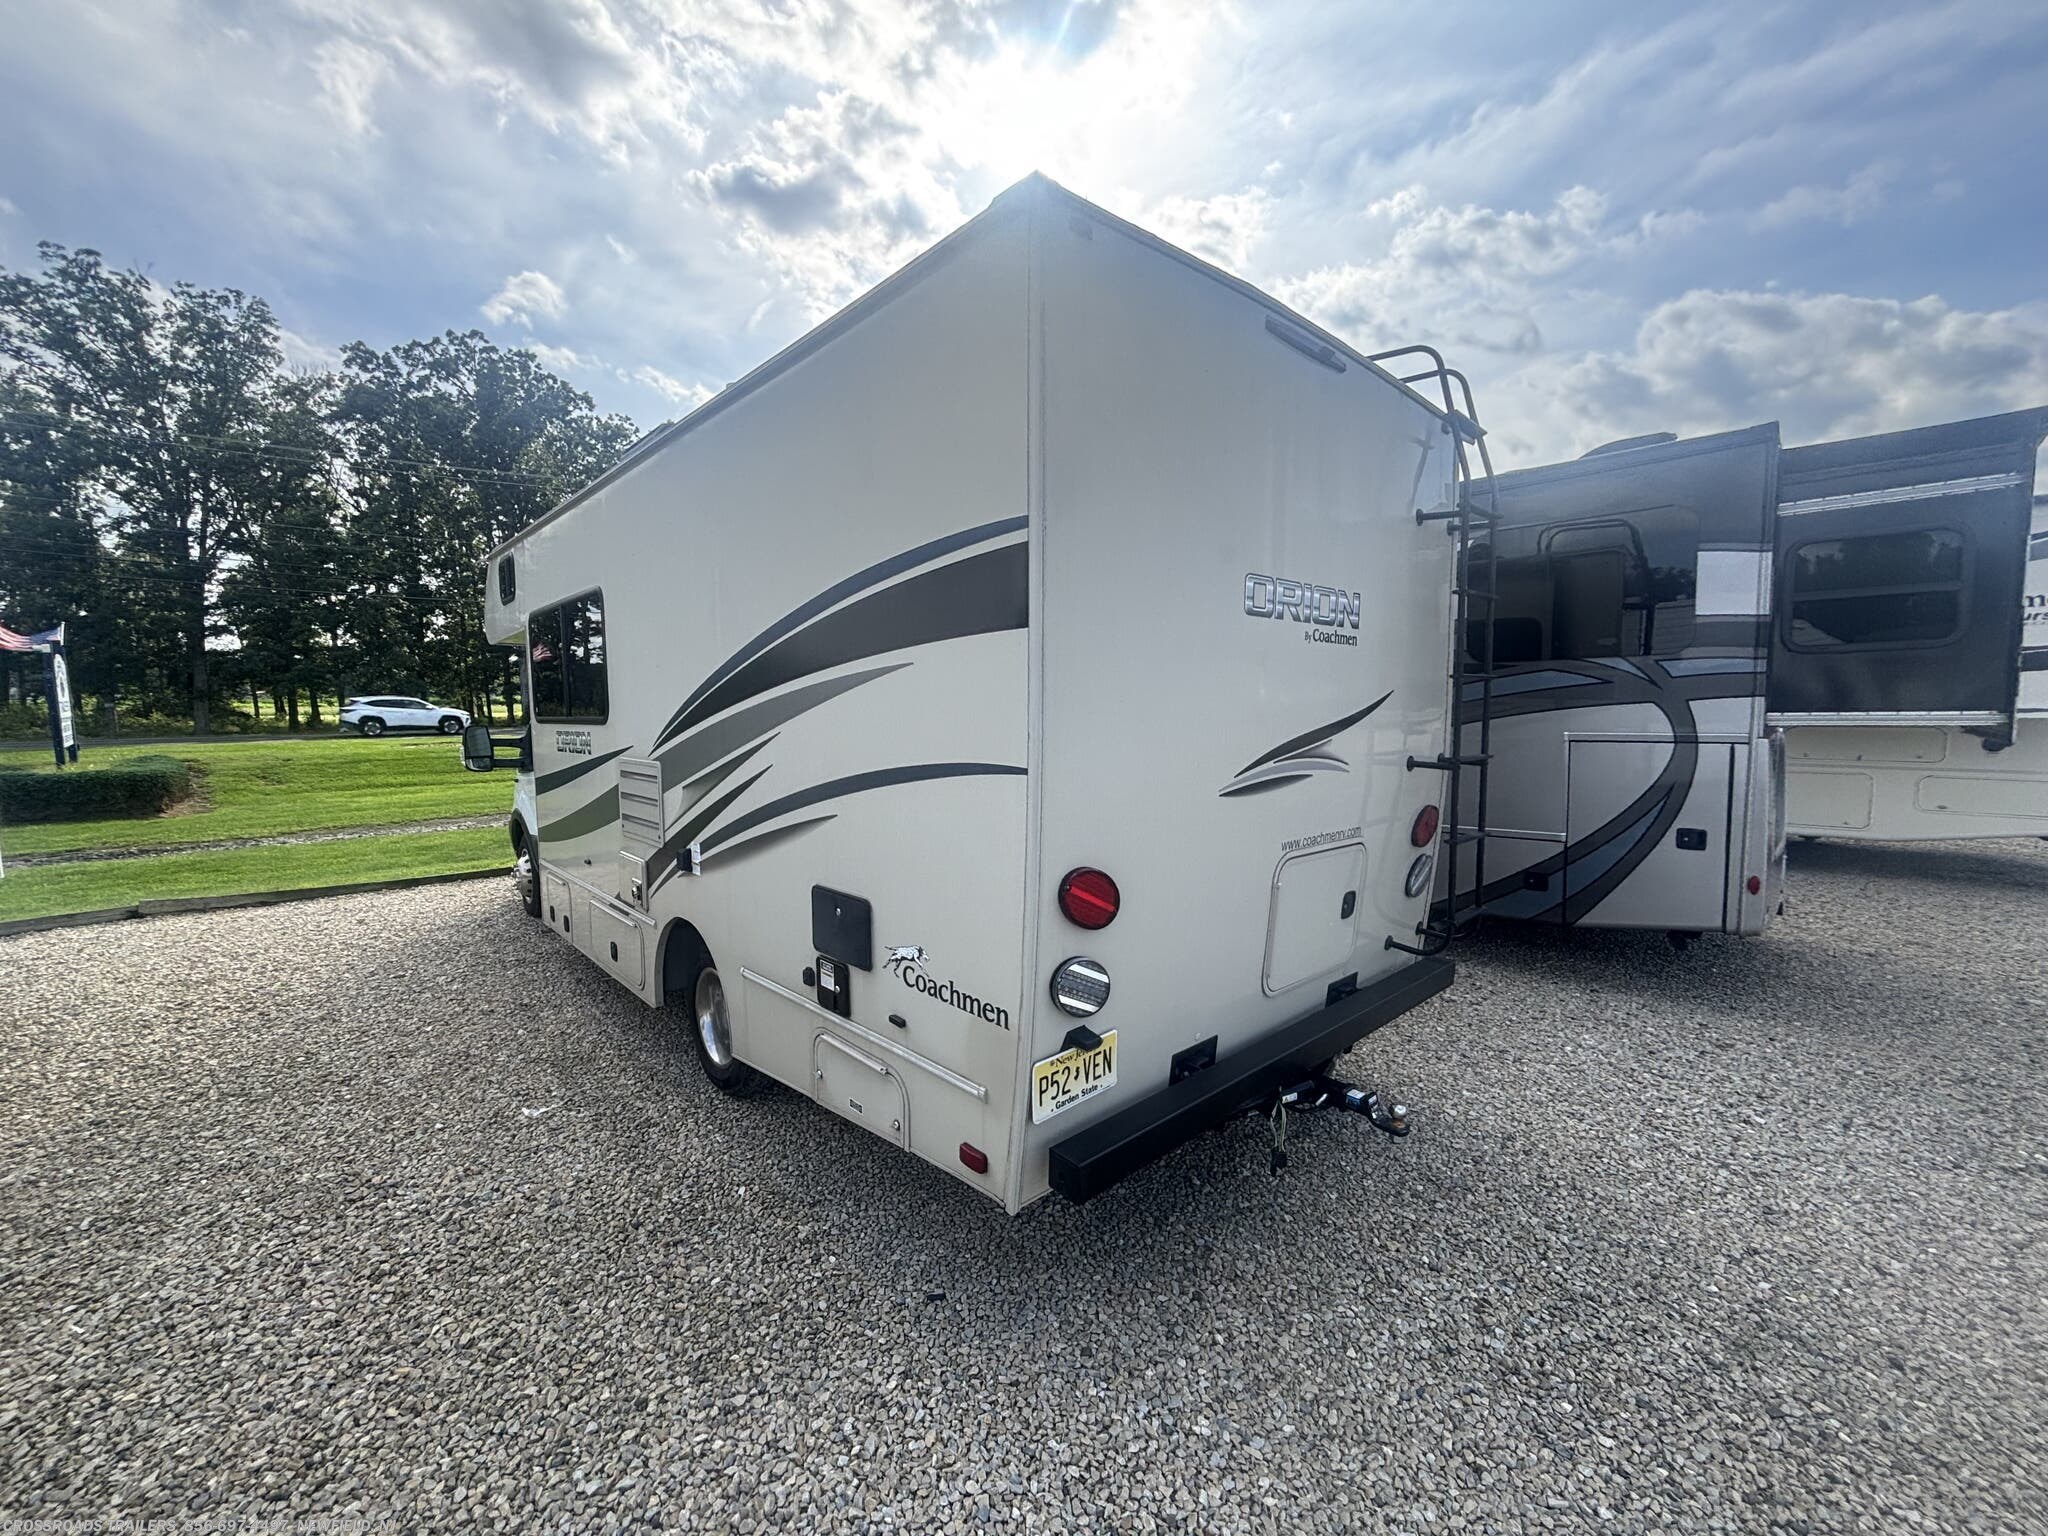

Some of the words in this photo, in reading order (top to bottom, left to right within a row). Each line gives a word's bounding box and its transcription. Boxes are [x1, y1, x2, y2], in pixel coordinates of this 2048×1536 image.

[1244, 572, 1360, 629] ORION
[1304, 630, 1313, 644] By
[1312, 628, 1358, 646] Coachmen
[903, 965, 1010, 1031] Coachmen
[1039, 1065, 1071, 1107] P52
[1083, 1046, 1112, 1084] VEN
[1055, 1093, 1080, 1110] Garden
[1080, 1084, 1099, 1098] State
